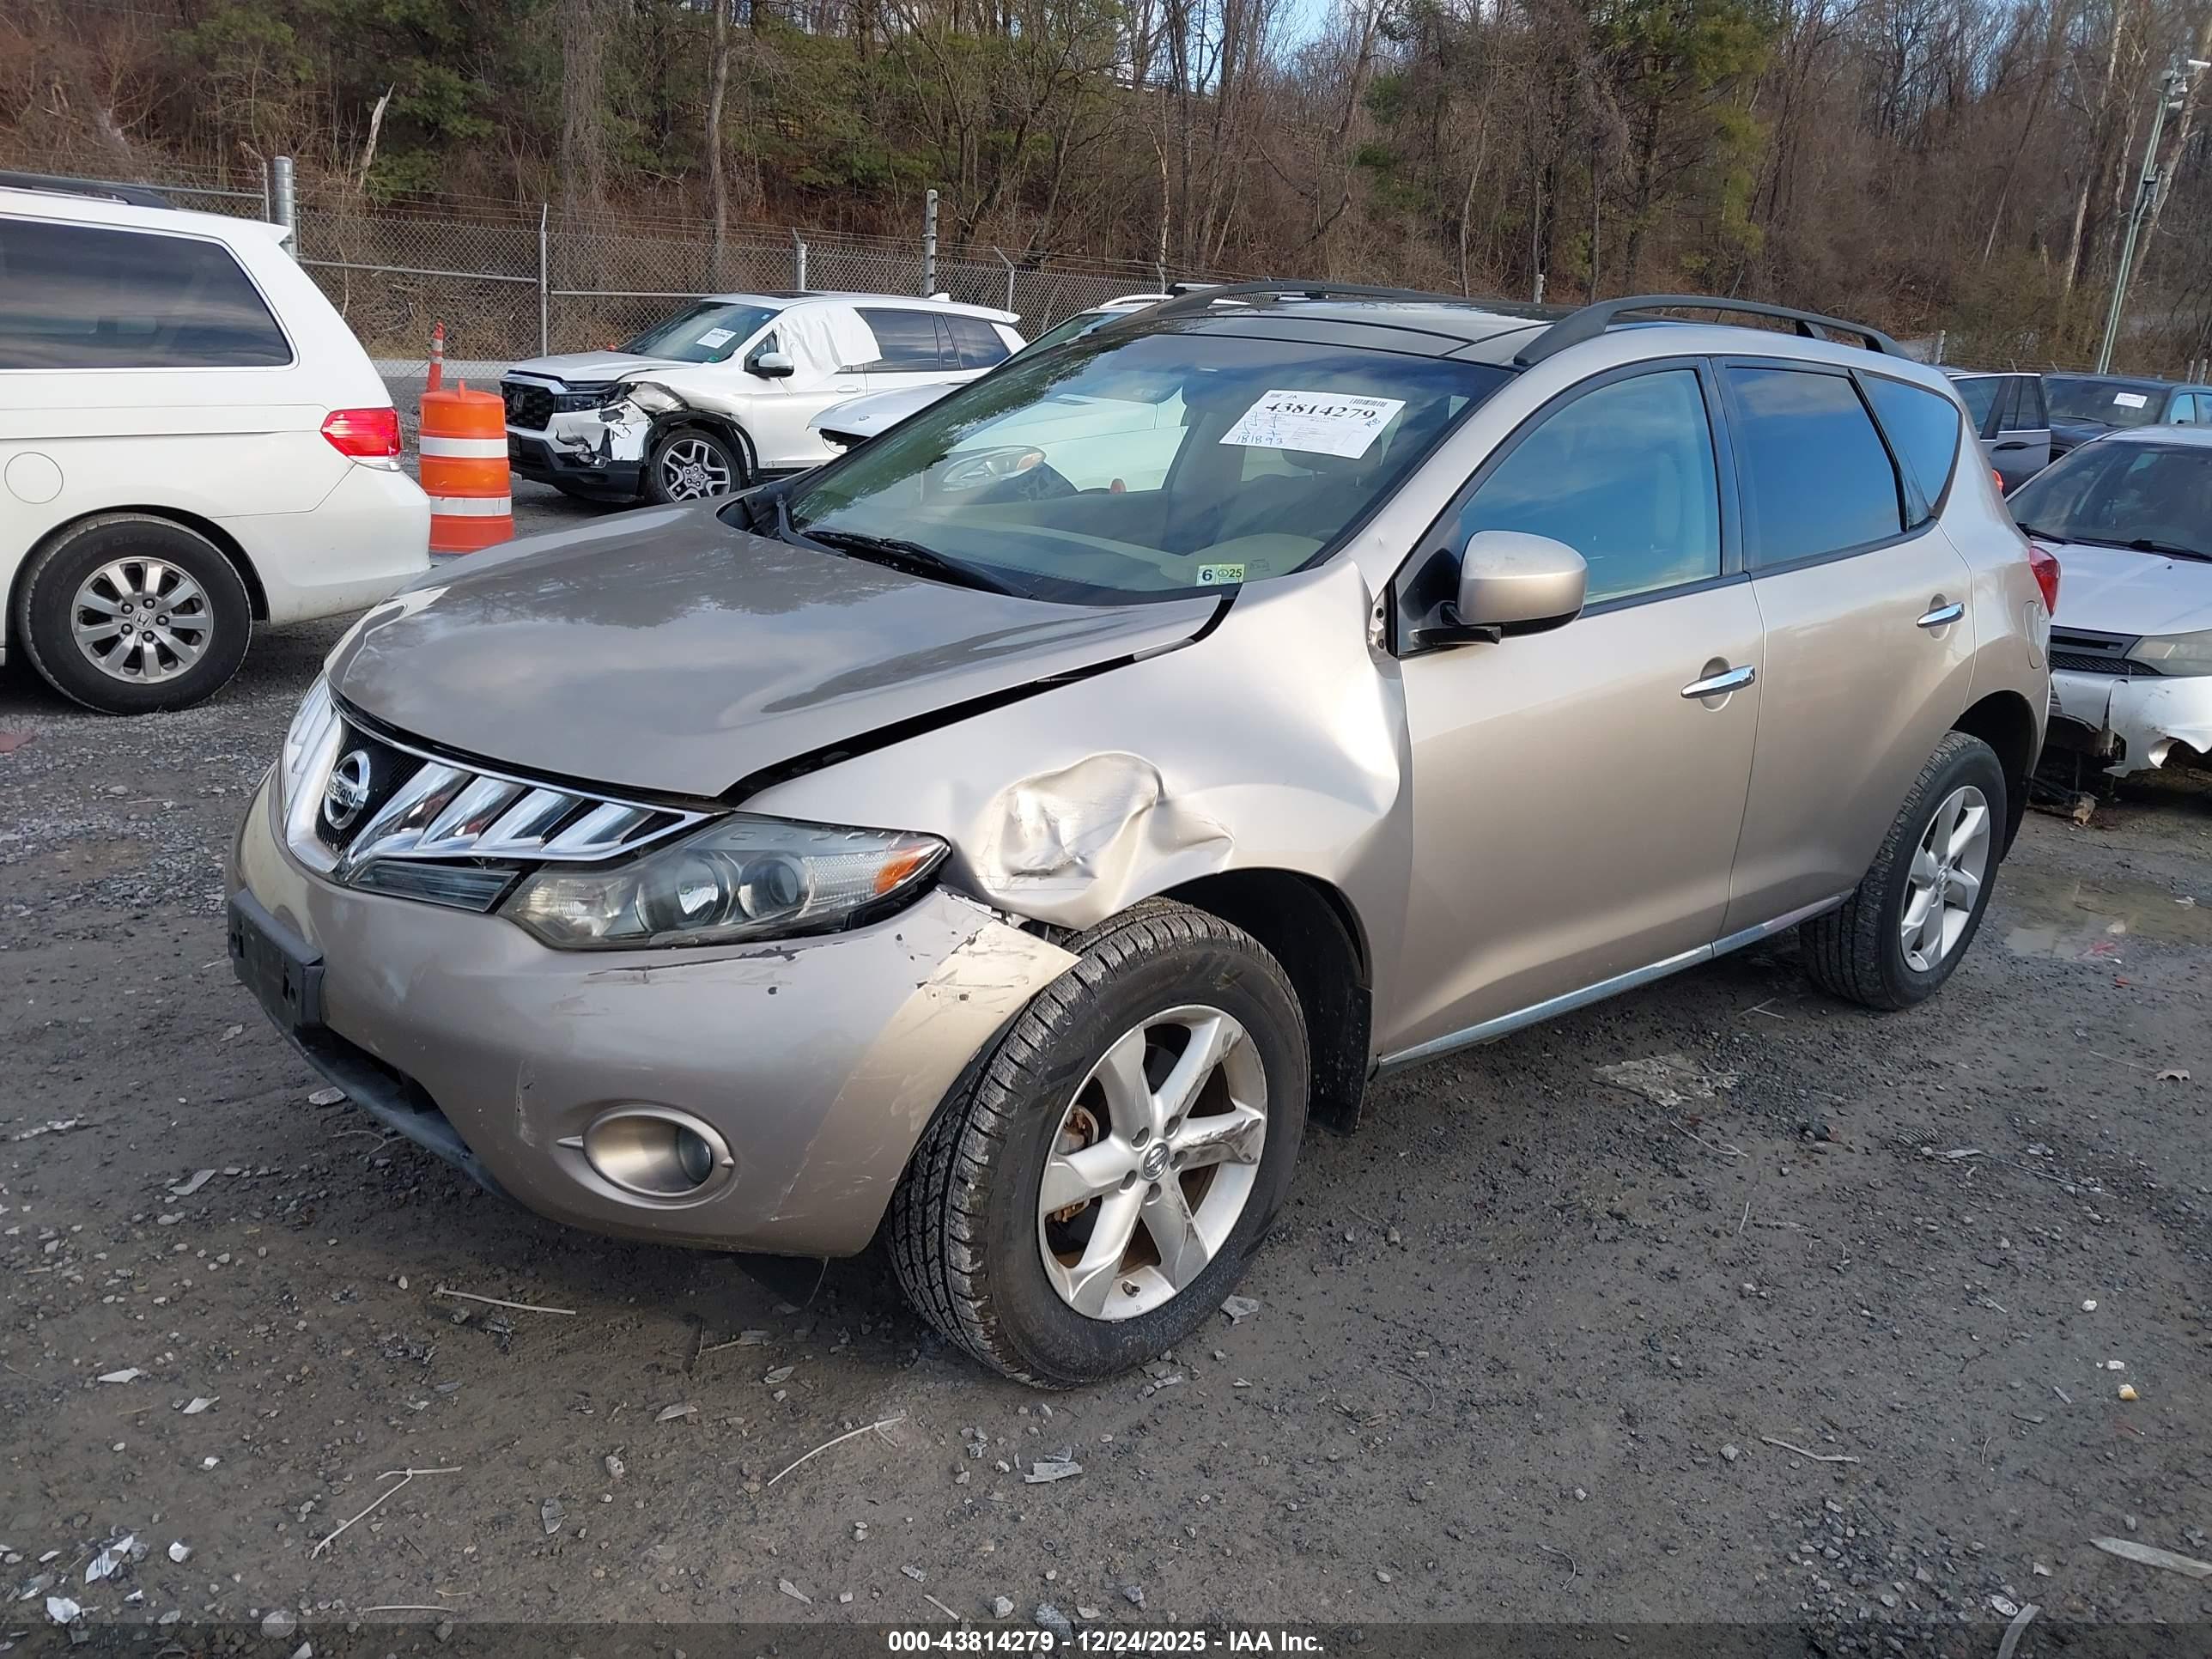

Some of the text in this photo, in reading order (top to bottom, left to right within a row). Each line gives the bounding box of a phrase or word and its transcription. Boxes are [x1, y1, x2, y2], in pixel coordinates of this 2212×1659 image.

[1265, 402, 1376, 420] 43814279
[1202, 568, 1243, 581] 6 25
